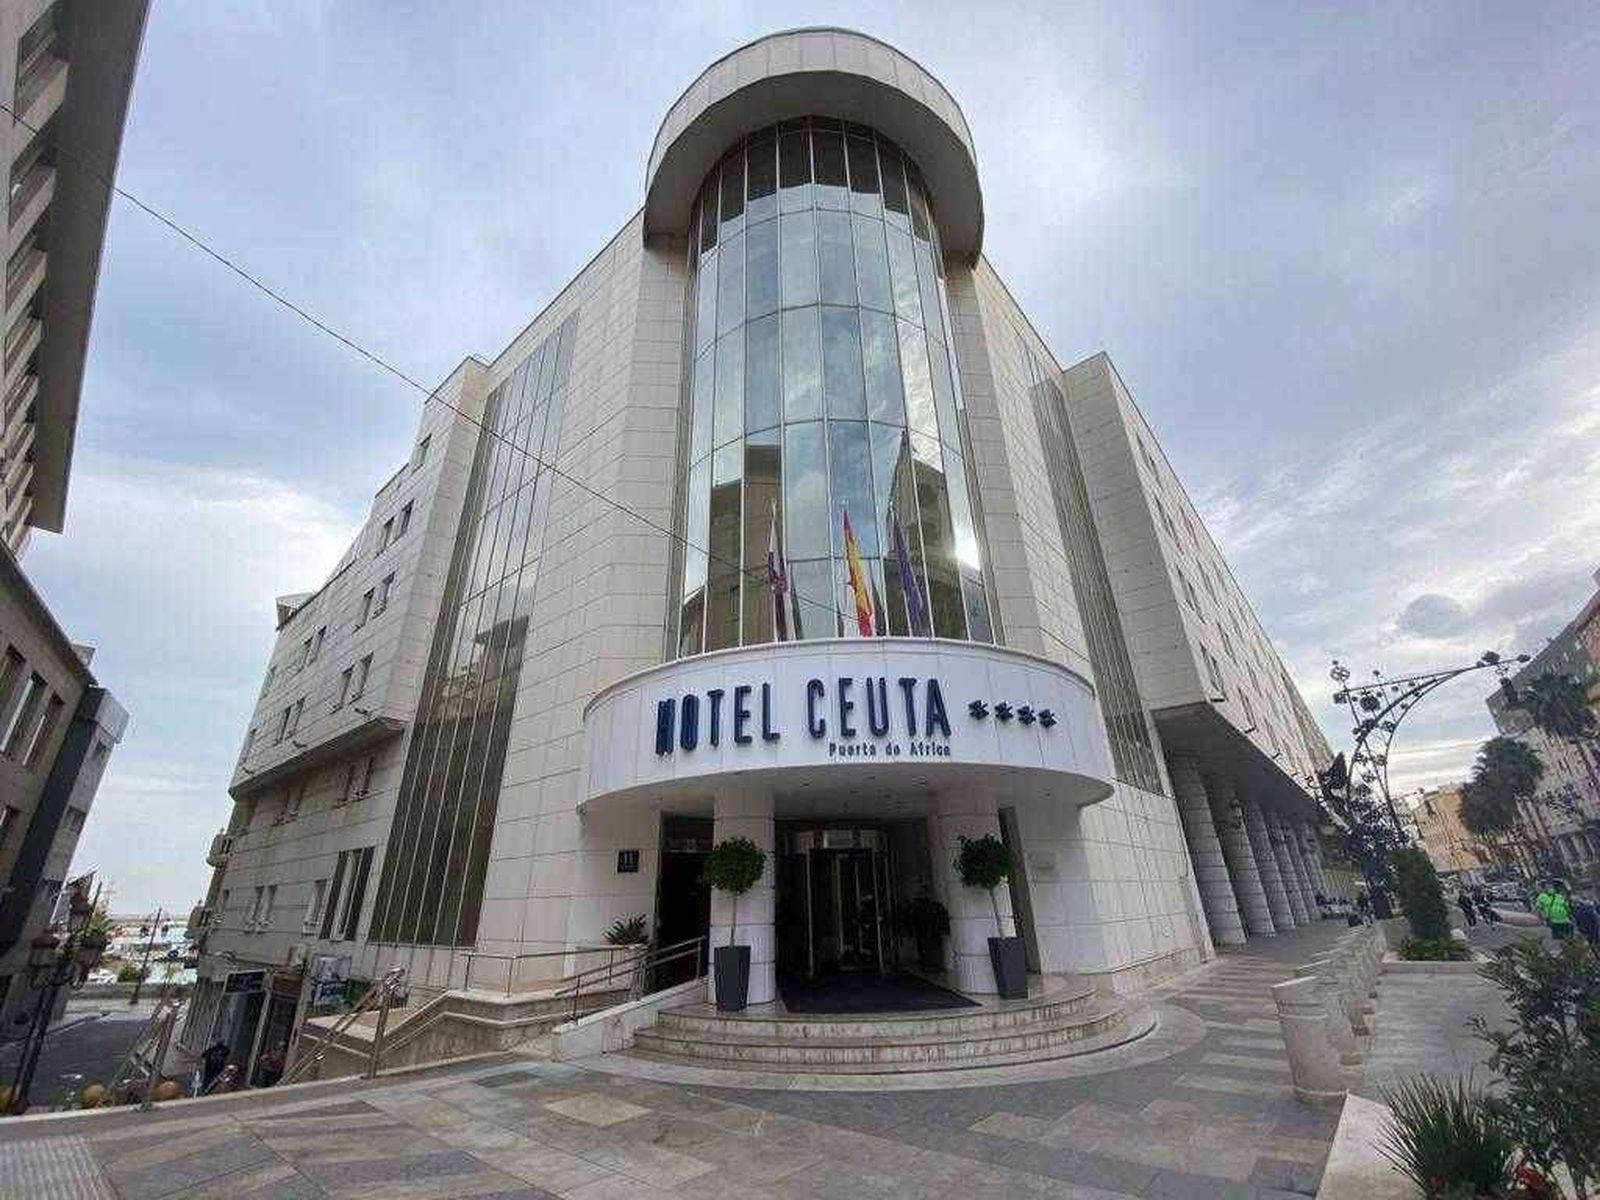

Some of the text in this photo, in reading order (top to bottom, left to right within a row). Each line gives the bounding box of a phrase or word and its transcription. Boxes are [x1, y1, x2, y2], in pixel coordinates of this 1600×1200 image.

[655, 677, 951, 755] HOTEL CEUTA
[829, 742, 876, 757] Puerta
[885, 742, 901, 756] de
